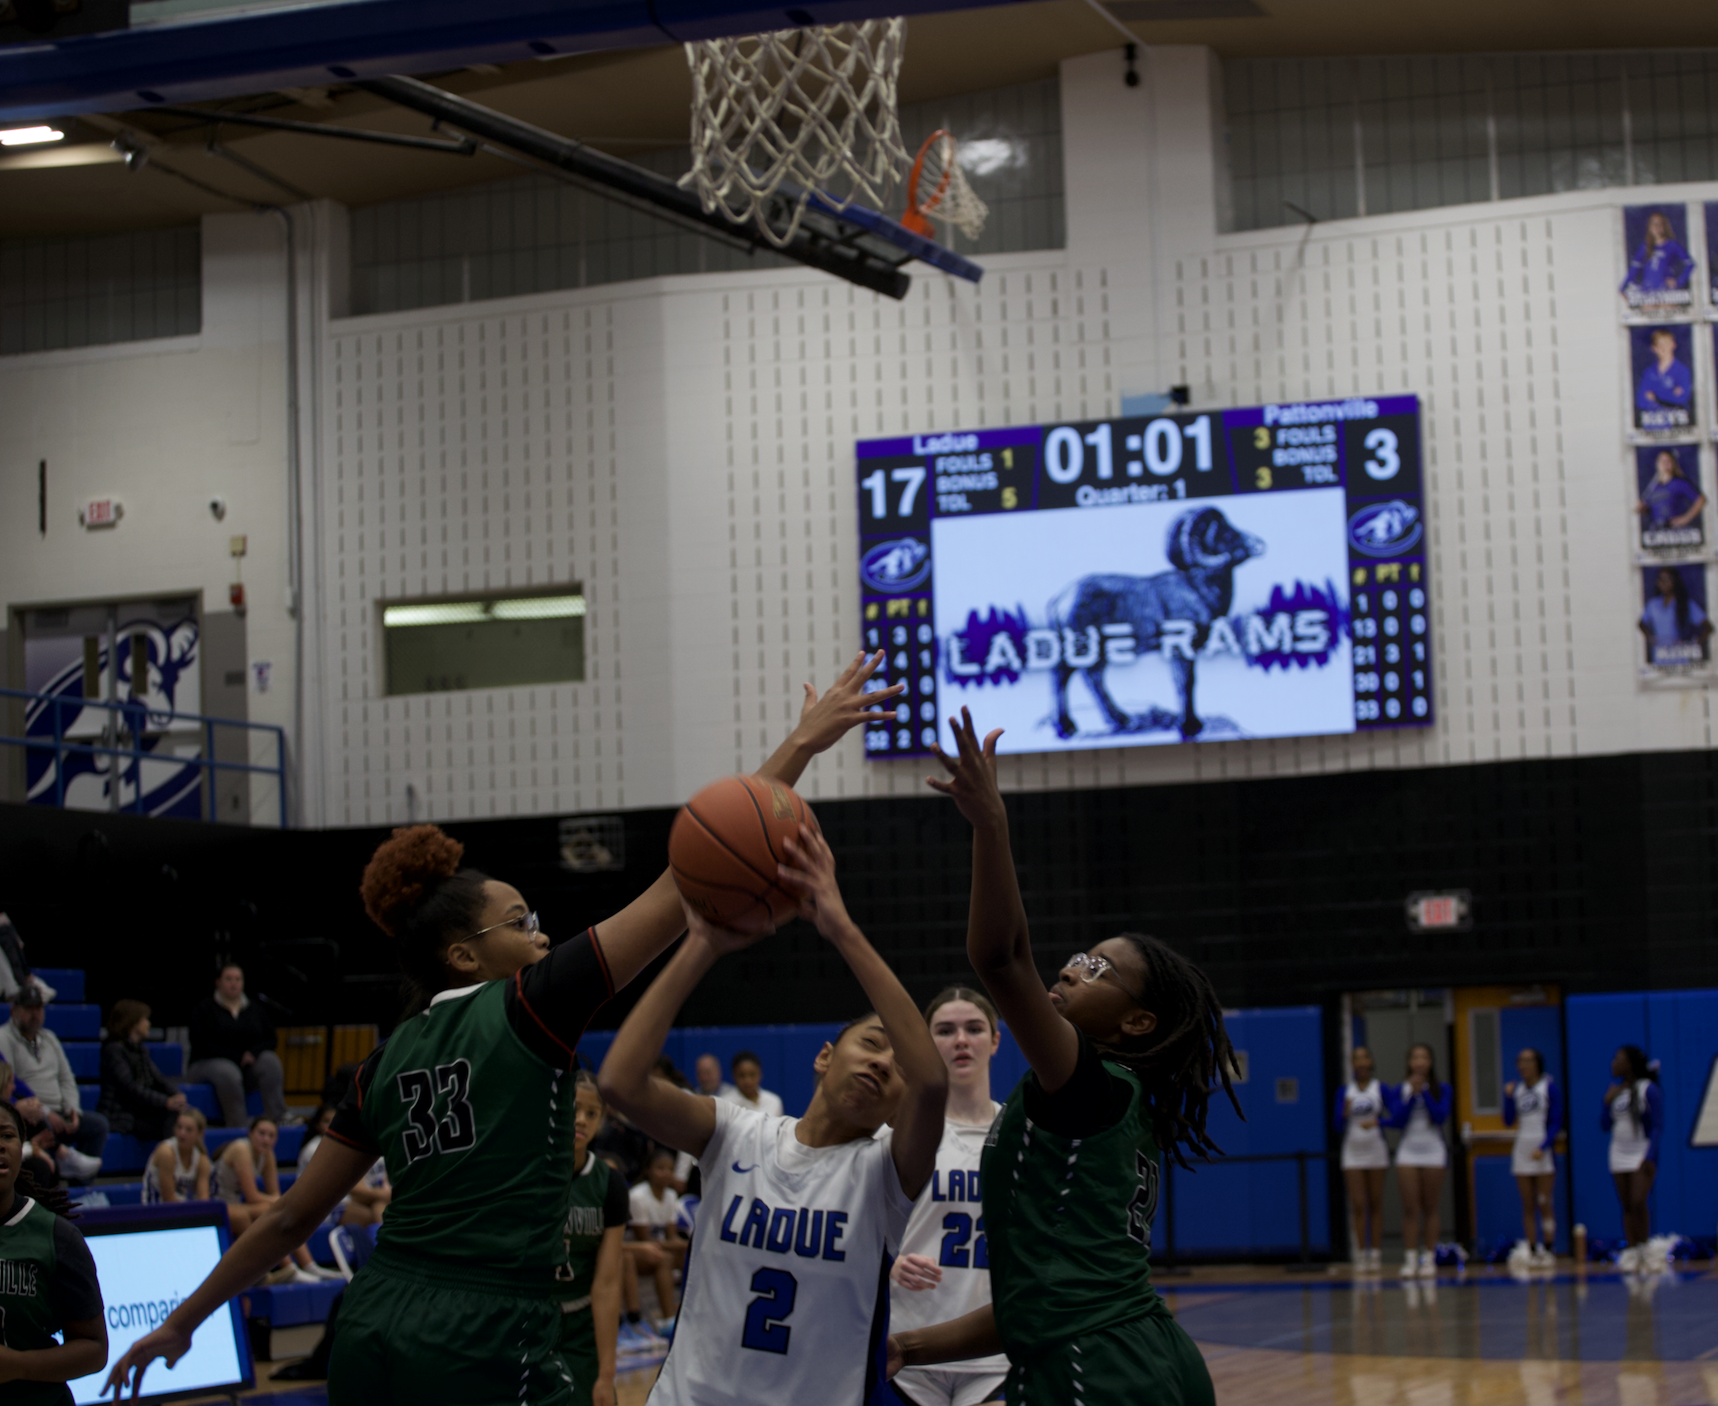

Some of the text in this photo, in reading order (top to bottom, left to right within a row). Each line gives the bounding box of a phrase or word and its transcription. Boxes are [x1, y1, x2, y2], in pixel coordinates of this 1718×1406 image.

[1263, 397, 1379, 427] Pattonville
[913, 432, 979, 456] Ladue
[1044, 415, 1213, 484] 01:01
[1253, 424, 1337, 450] 3 FOULS
[935, 447, 1014, 474] FOULS 1
[1272, 444, 1338, 467] BONUS
[1364, 427, 1401, 481] 3
[936, 471, 999, 493] BONUS
[1255, 466, 1273, 490] 3
[861, 466, 927, 519] 17
[1075, 478, 1187, 507] Quarter: 1
[89, 499, 111, 523] EXIT
[1356, 593, 1368, 613] 1
[866, 627, 879, 647] 1
[947, 609, 1330, 676] LADUE RAMS
[893, 650, 908, 670] 4
[1424, 897, 1453, 926] EXIT
[396, 1056, 477, 1165] 33
[720, 1194, 848, 1262] LADUE
[742, 1265, 798, 1355] 2
